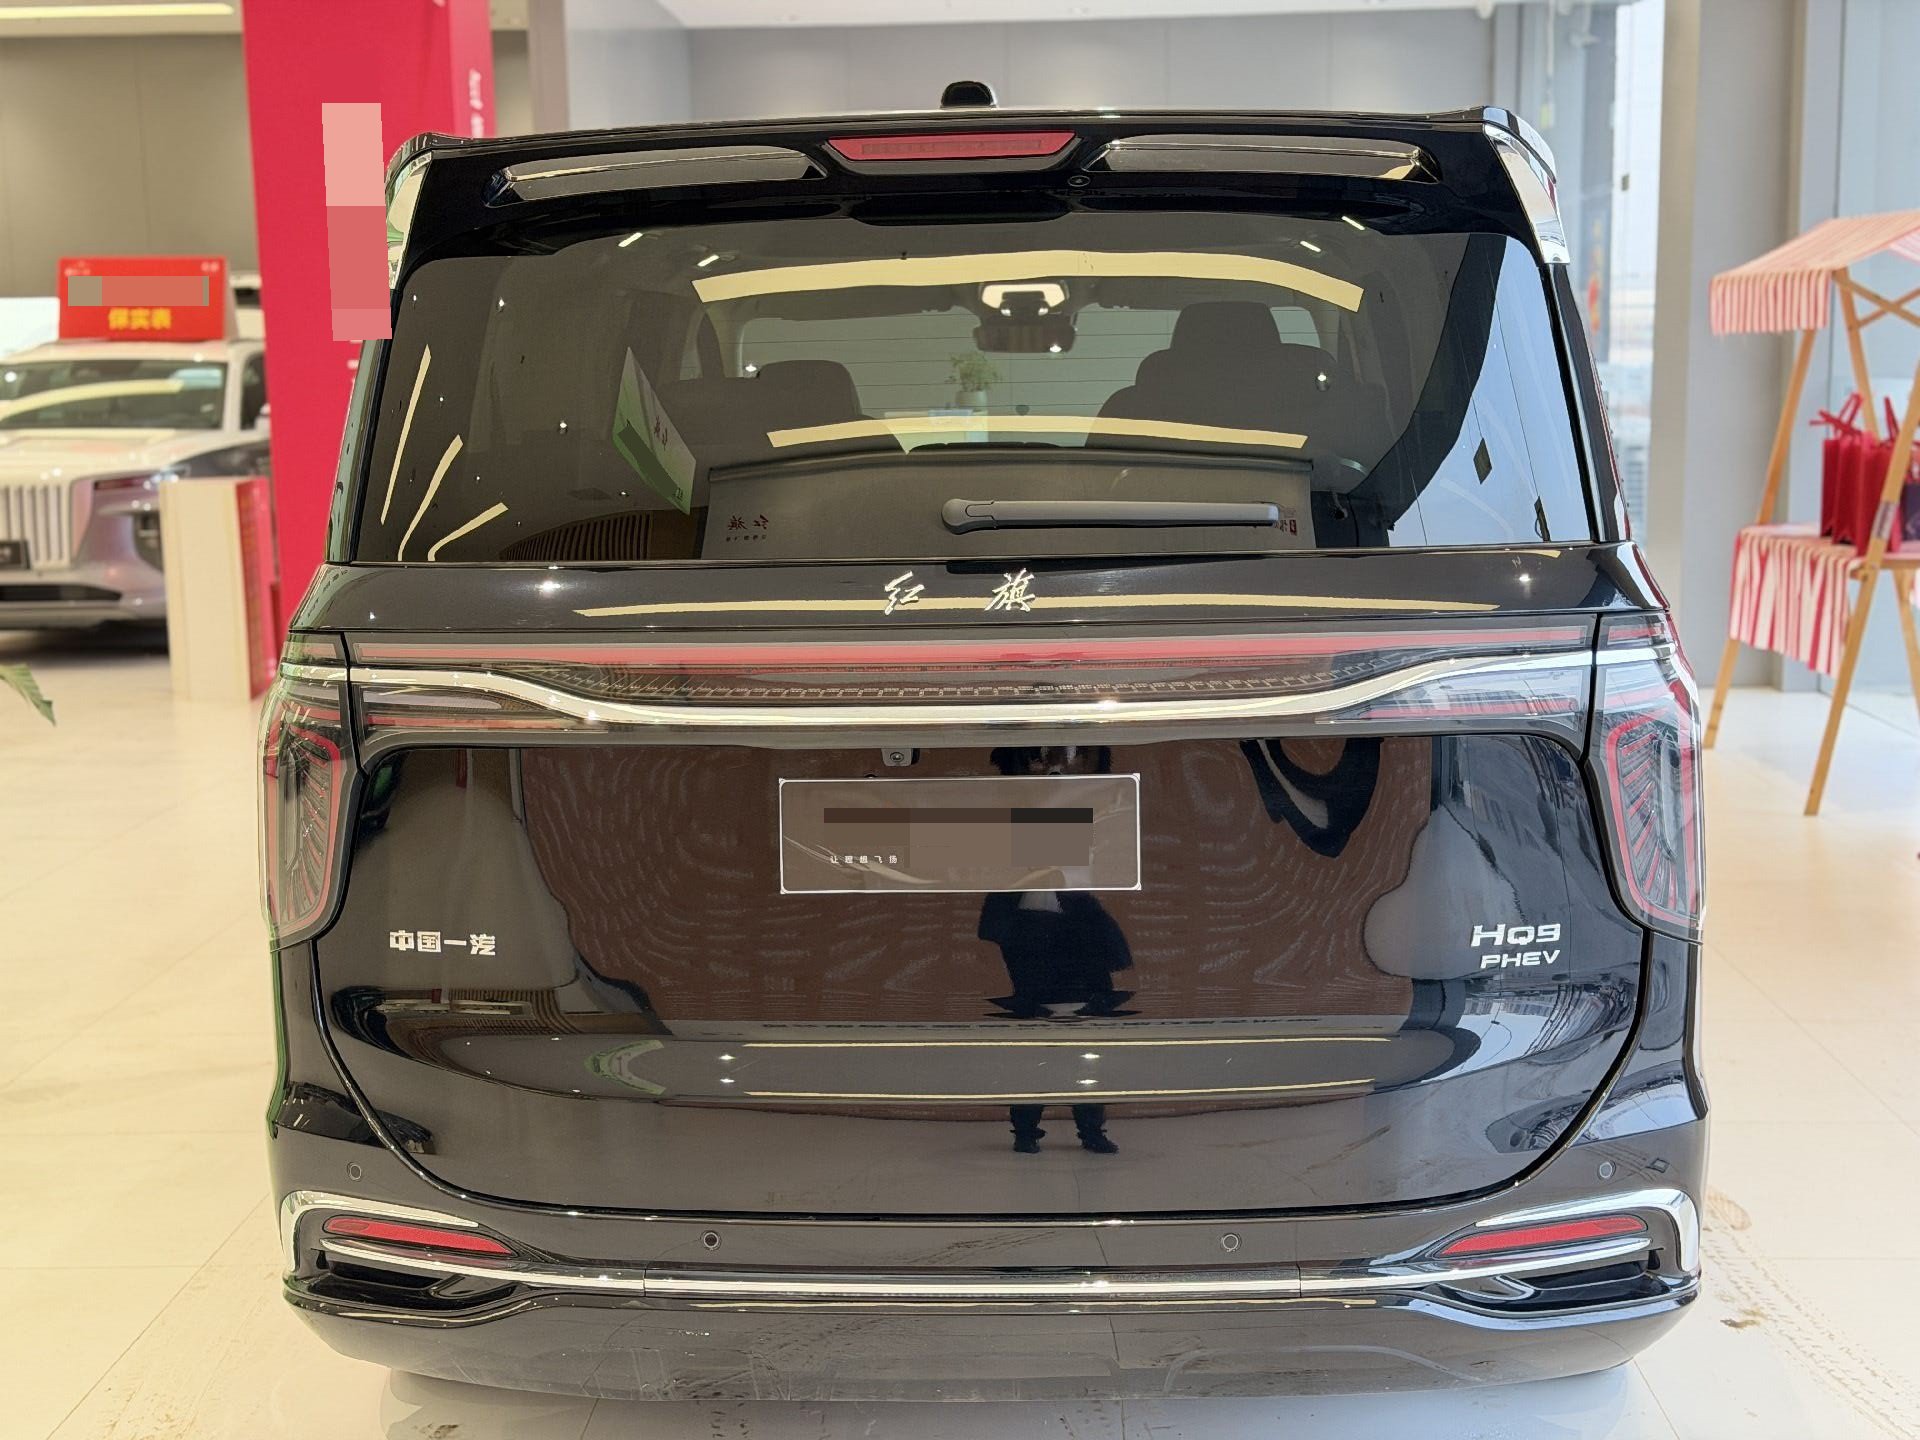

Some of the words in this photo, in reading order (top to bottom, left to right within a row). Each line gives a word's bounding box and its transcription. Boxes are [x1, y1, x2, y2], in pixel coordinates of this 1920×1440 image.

[884, 568, 1036, 616] 红旗
[830, 855, 898, 864] 让理想飞扬
[389, 929, 496, 956] 中国一汽
[1470, 923, 1561, 947] HQ9
[1480, 949, 1561, 969] PHEV
